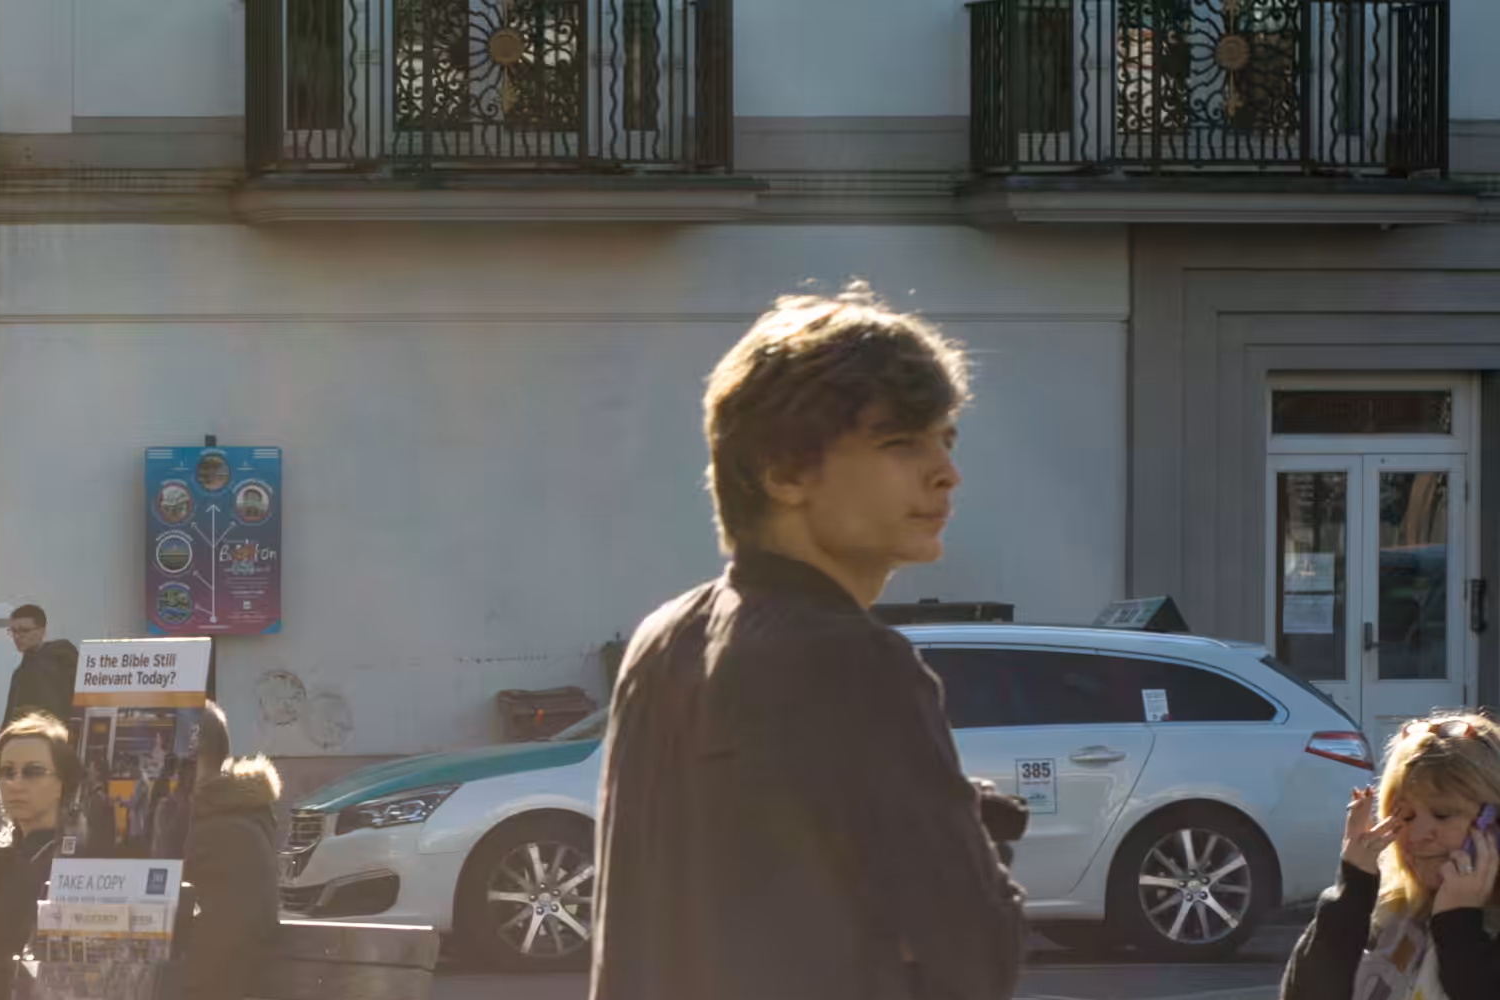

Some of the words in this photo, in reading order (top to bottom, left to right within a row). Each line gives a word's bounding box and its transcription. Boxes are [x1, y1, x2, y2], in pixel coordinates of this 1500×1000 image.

[86, 654, 96, 668] Is
[99, 654, 119, 668] the
[121, 653, 150, 668] Bible
[153, 653, 177, 667] Still
[84, 671, 133, 686] Relevant
[137, 671, 177, 689] Today?
[1021, 762, 1052, 779] 385
[58, 874, 84, 890] TAKE
[86, 874, 94, 890] A
[96, 874, 127, 891] COPY
